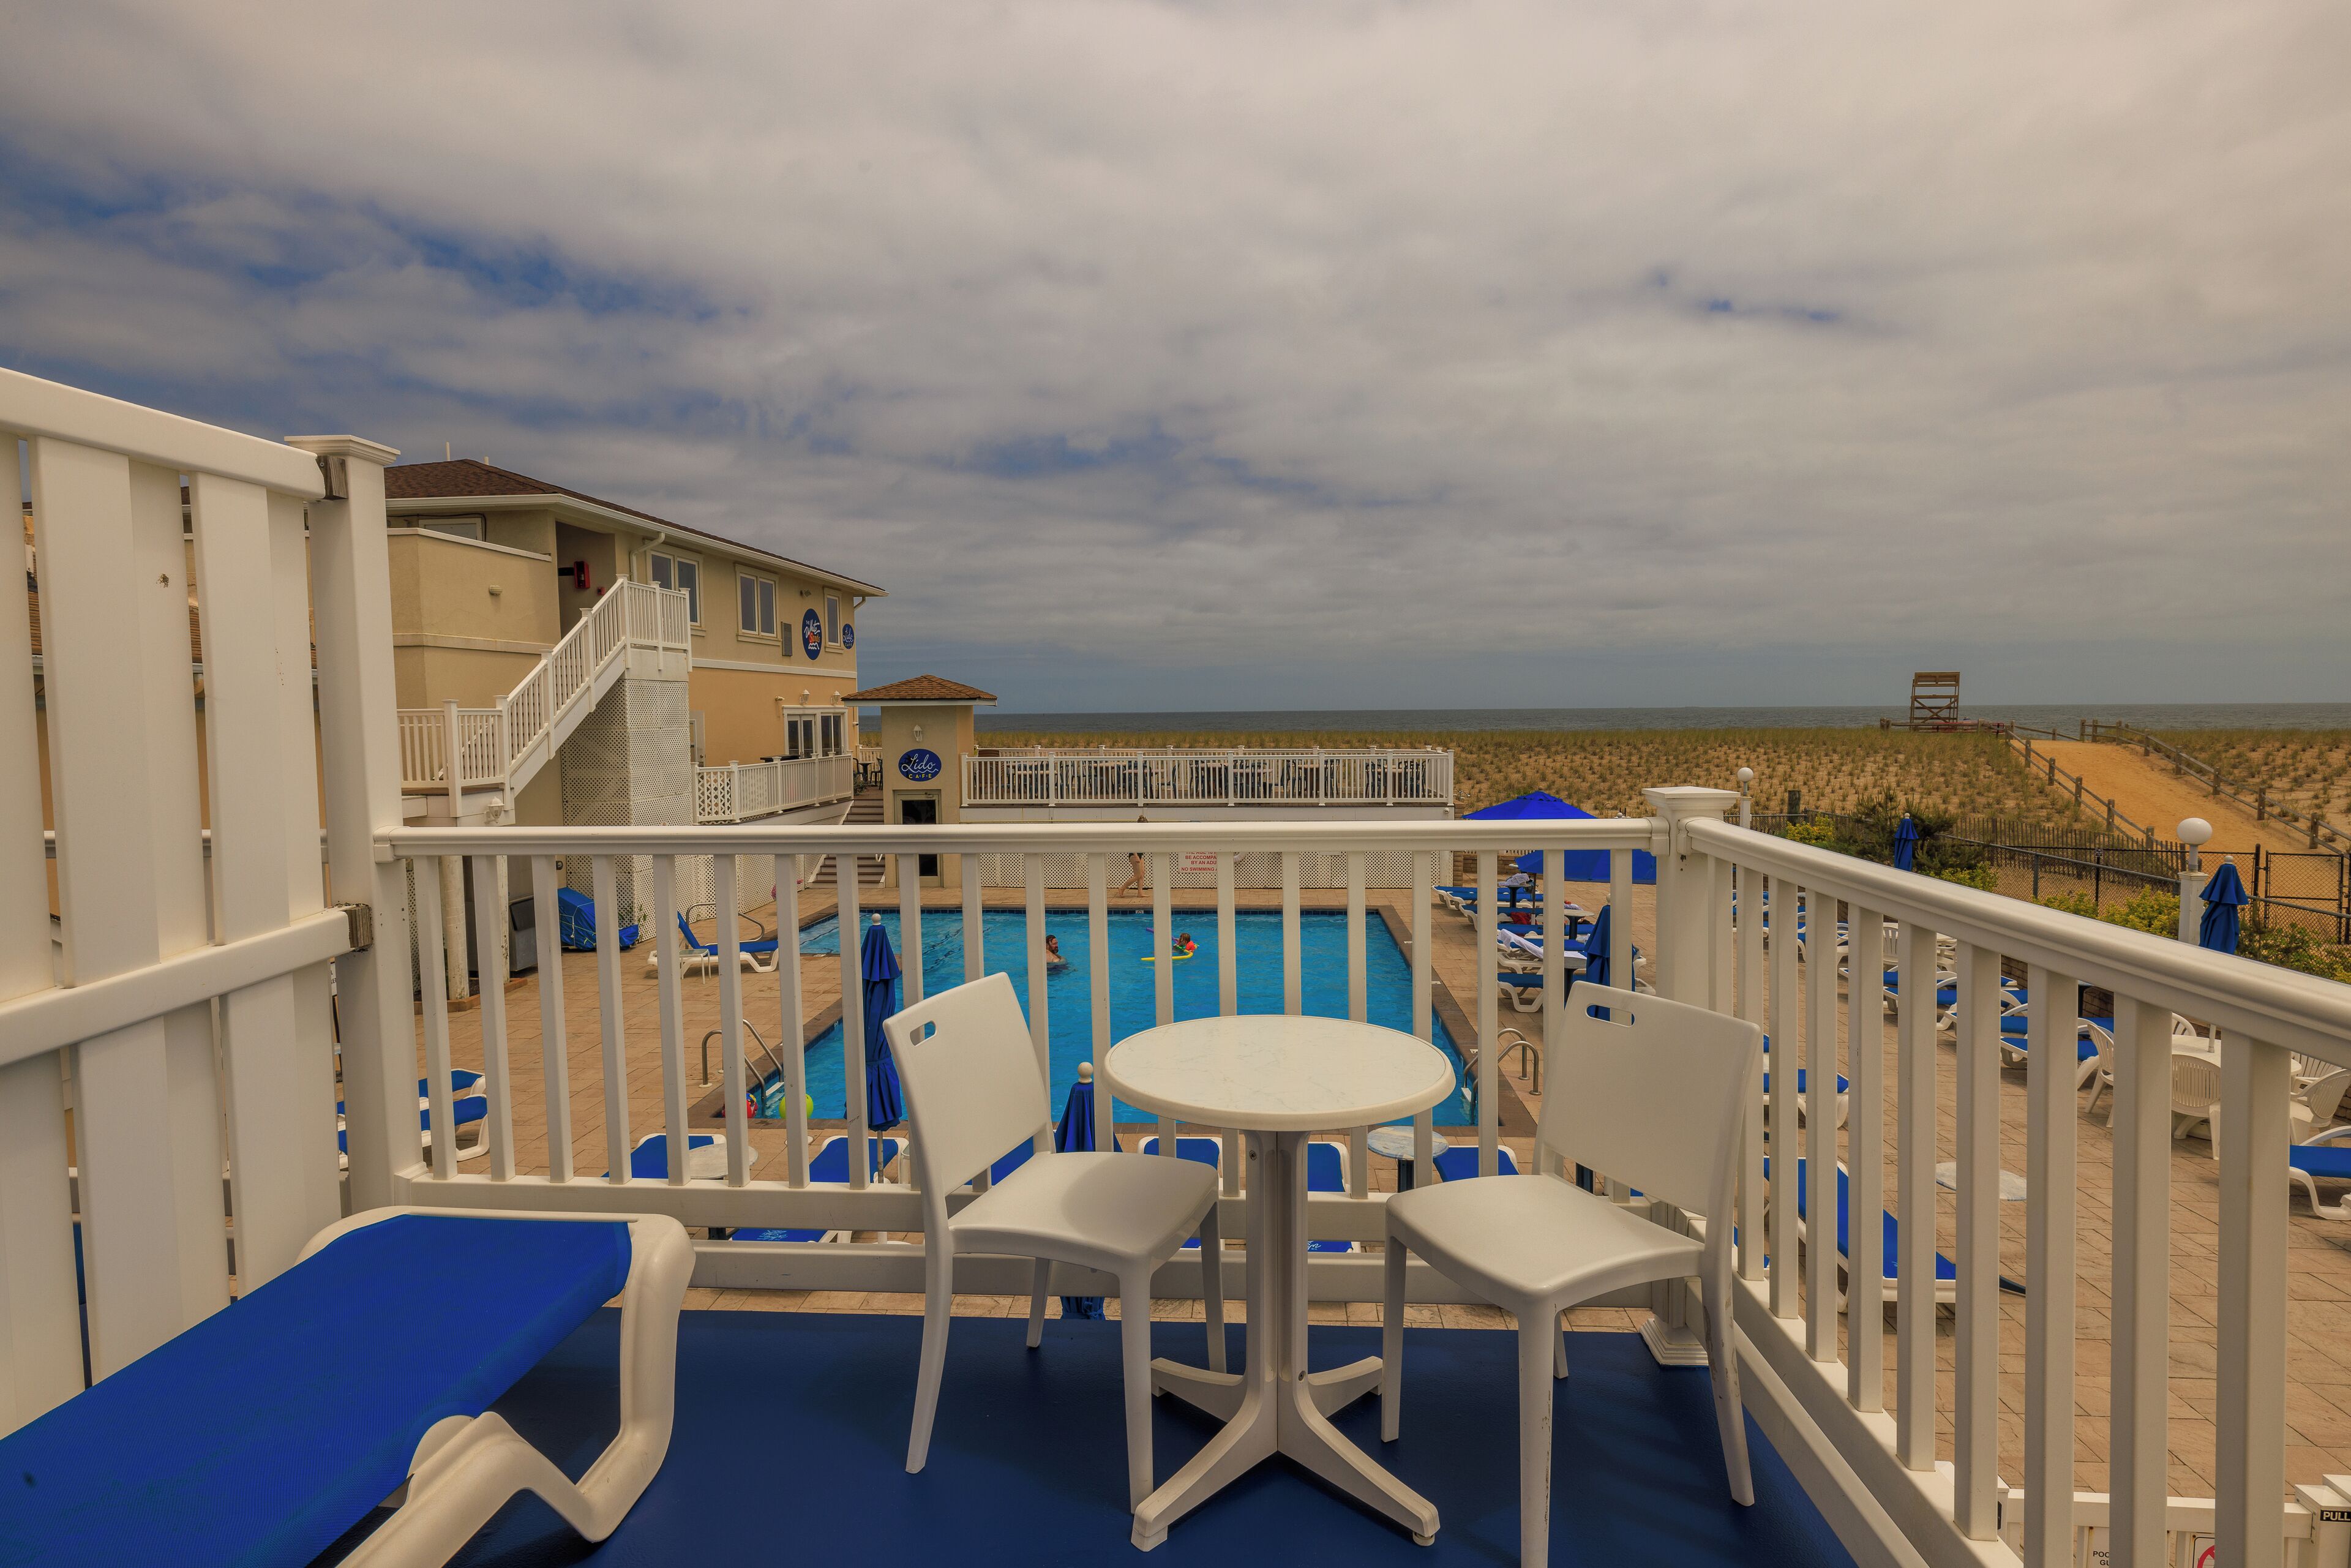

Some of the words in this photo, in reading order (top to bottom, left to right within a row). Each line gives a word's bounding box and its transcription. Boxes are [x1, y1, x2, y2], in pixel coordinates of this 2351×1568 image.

[804, 619, 820, 638] White
[901, 754, 939, 773] Lido
[2323, 1511, 2350, 1521] PULL
